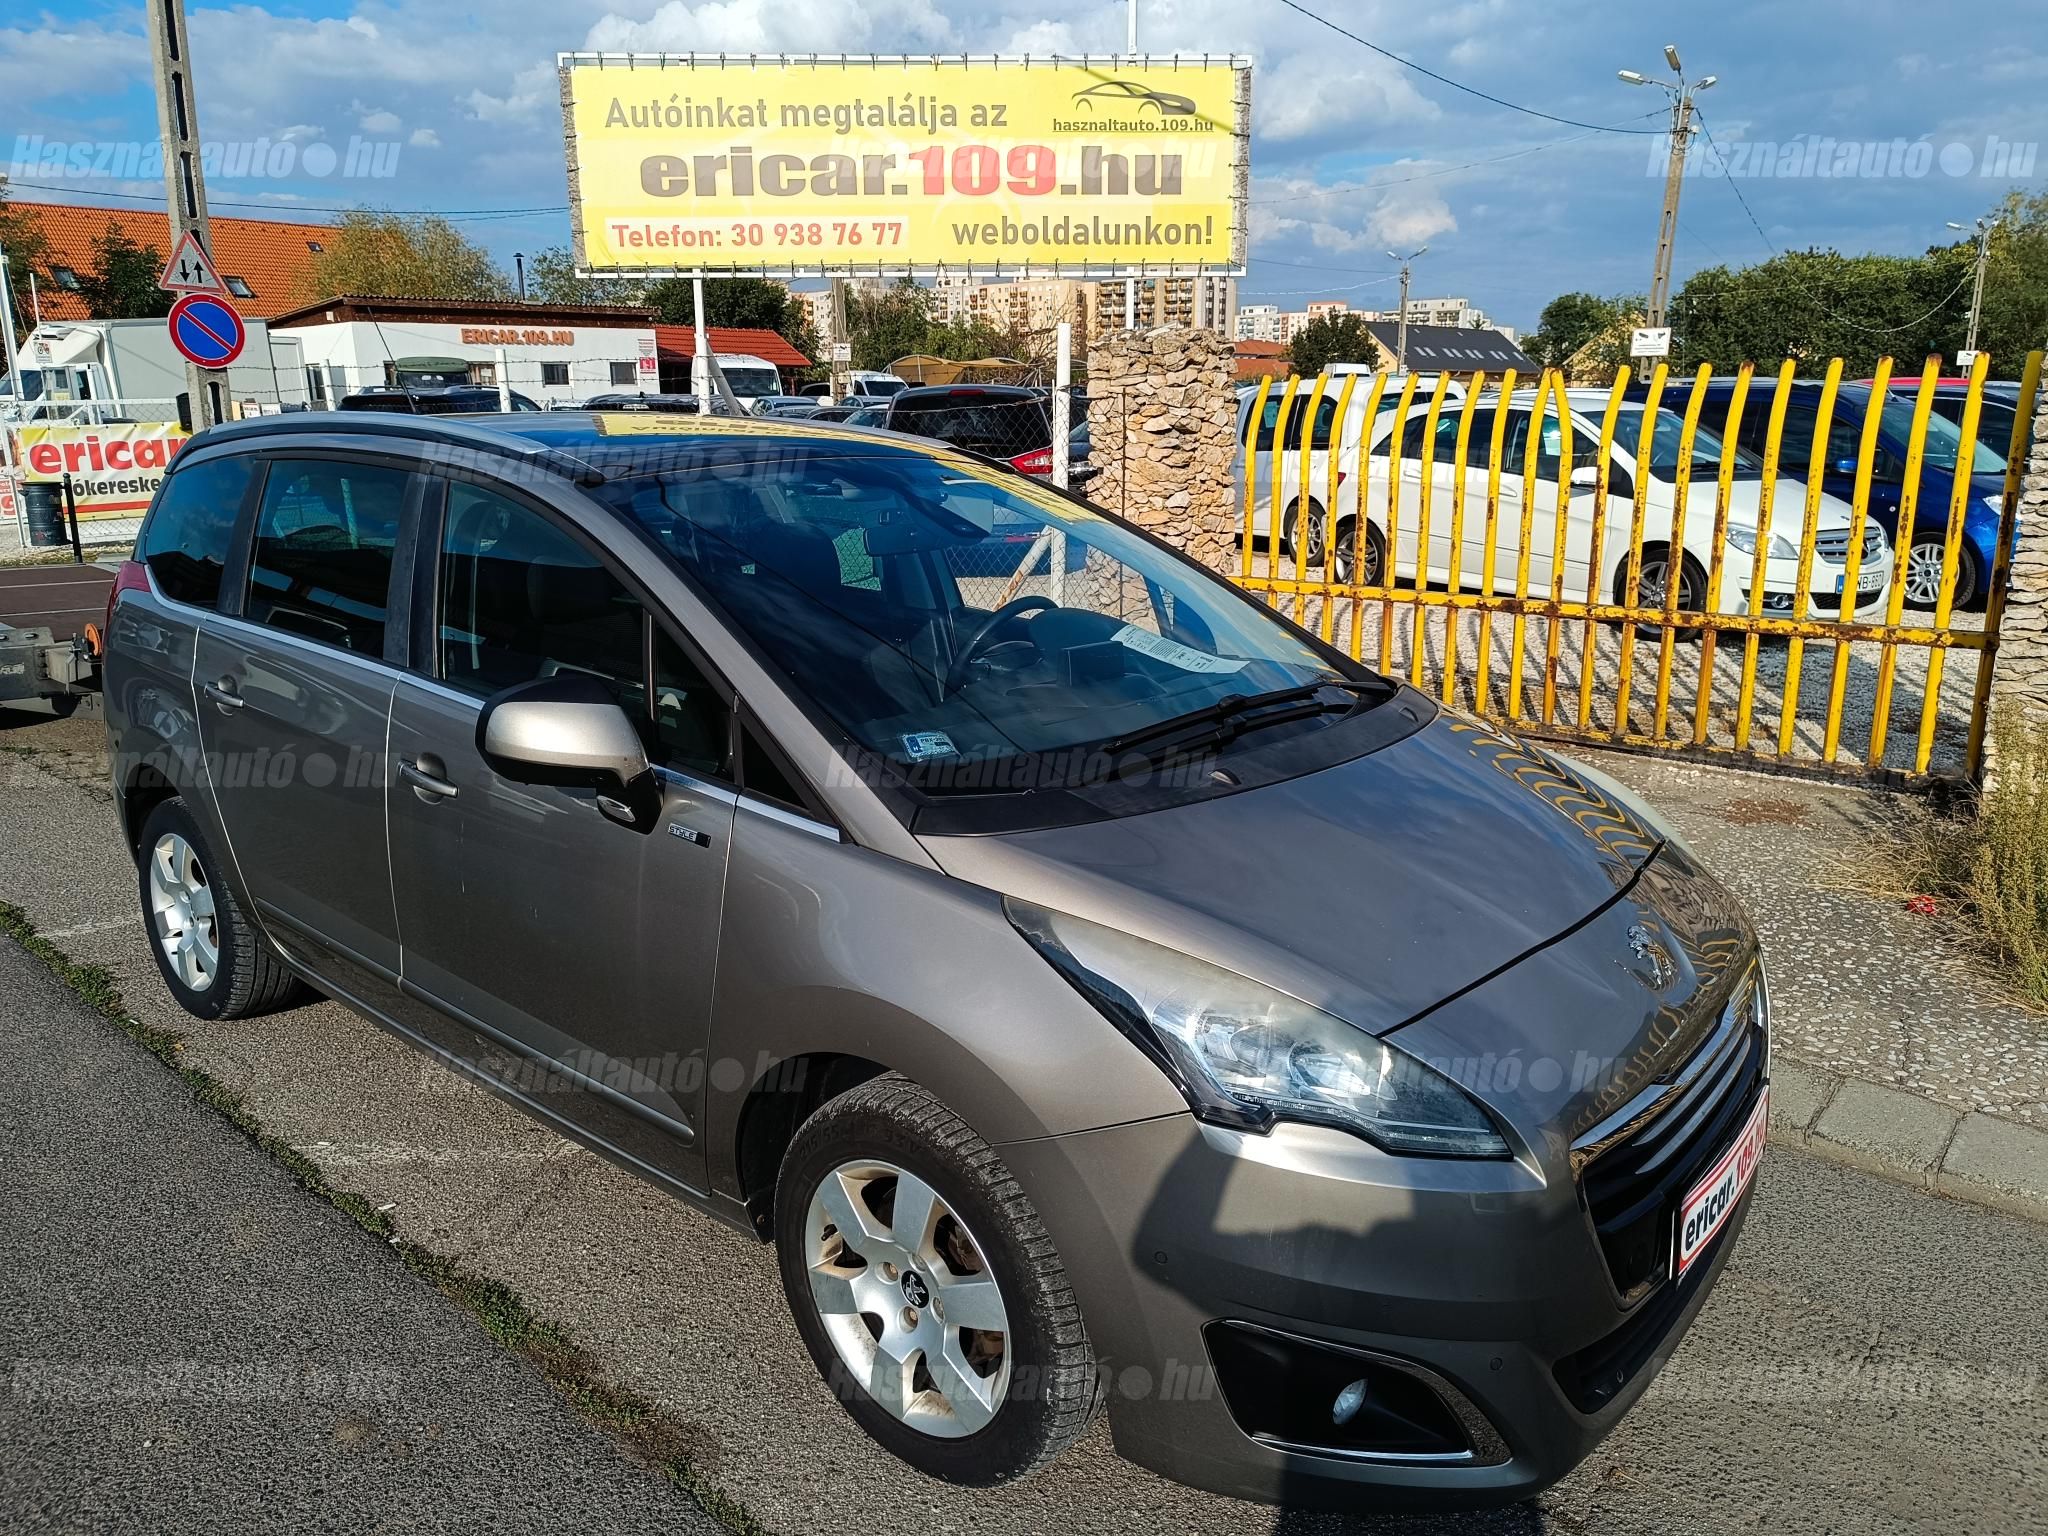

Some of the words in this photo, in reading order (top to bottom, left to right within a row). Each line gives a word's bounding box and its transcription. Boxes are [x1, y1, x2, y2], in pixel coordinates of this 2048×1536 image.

[605, 93, 767, 128] Autóinkat
[781, 92, 957, 135] megtalálja
[970, 104, 1008, 127] az
[1053, 119, 1214, 132] hasznaltauto.109.hu
[640, 145, 1182, 197] ericar.109.hu
[612, 225, 722, 247] Telefon:
[731, 223, 763, 246] 30
[774, 223, 823, 246] 938
[832, 223, 863, 245] 76
[872, 223, 902, 245] 77
[952, 215, 1212, 246] weboldalunkon!
[73, 477, 160, 497] ókereske
